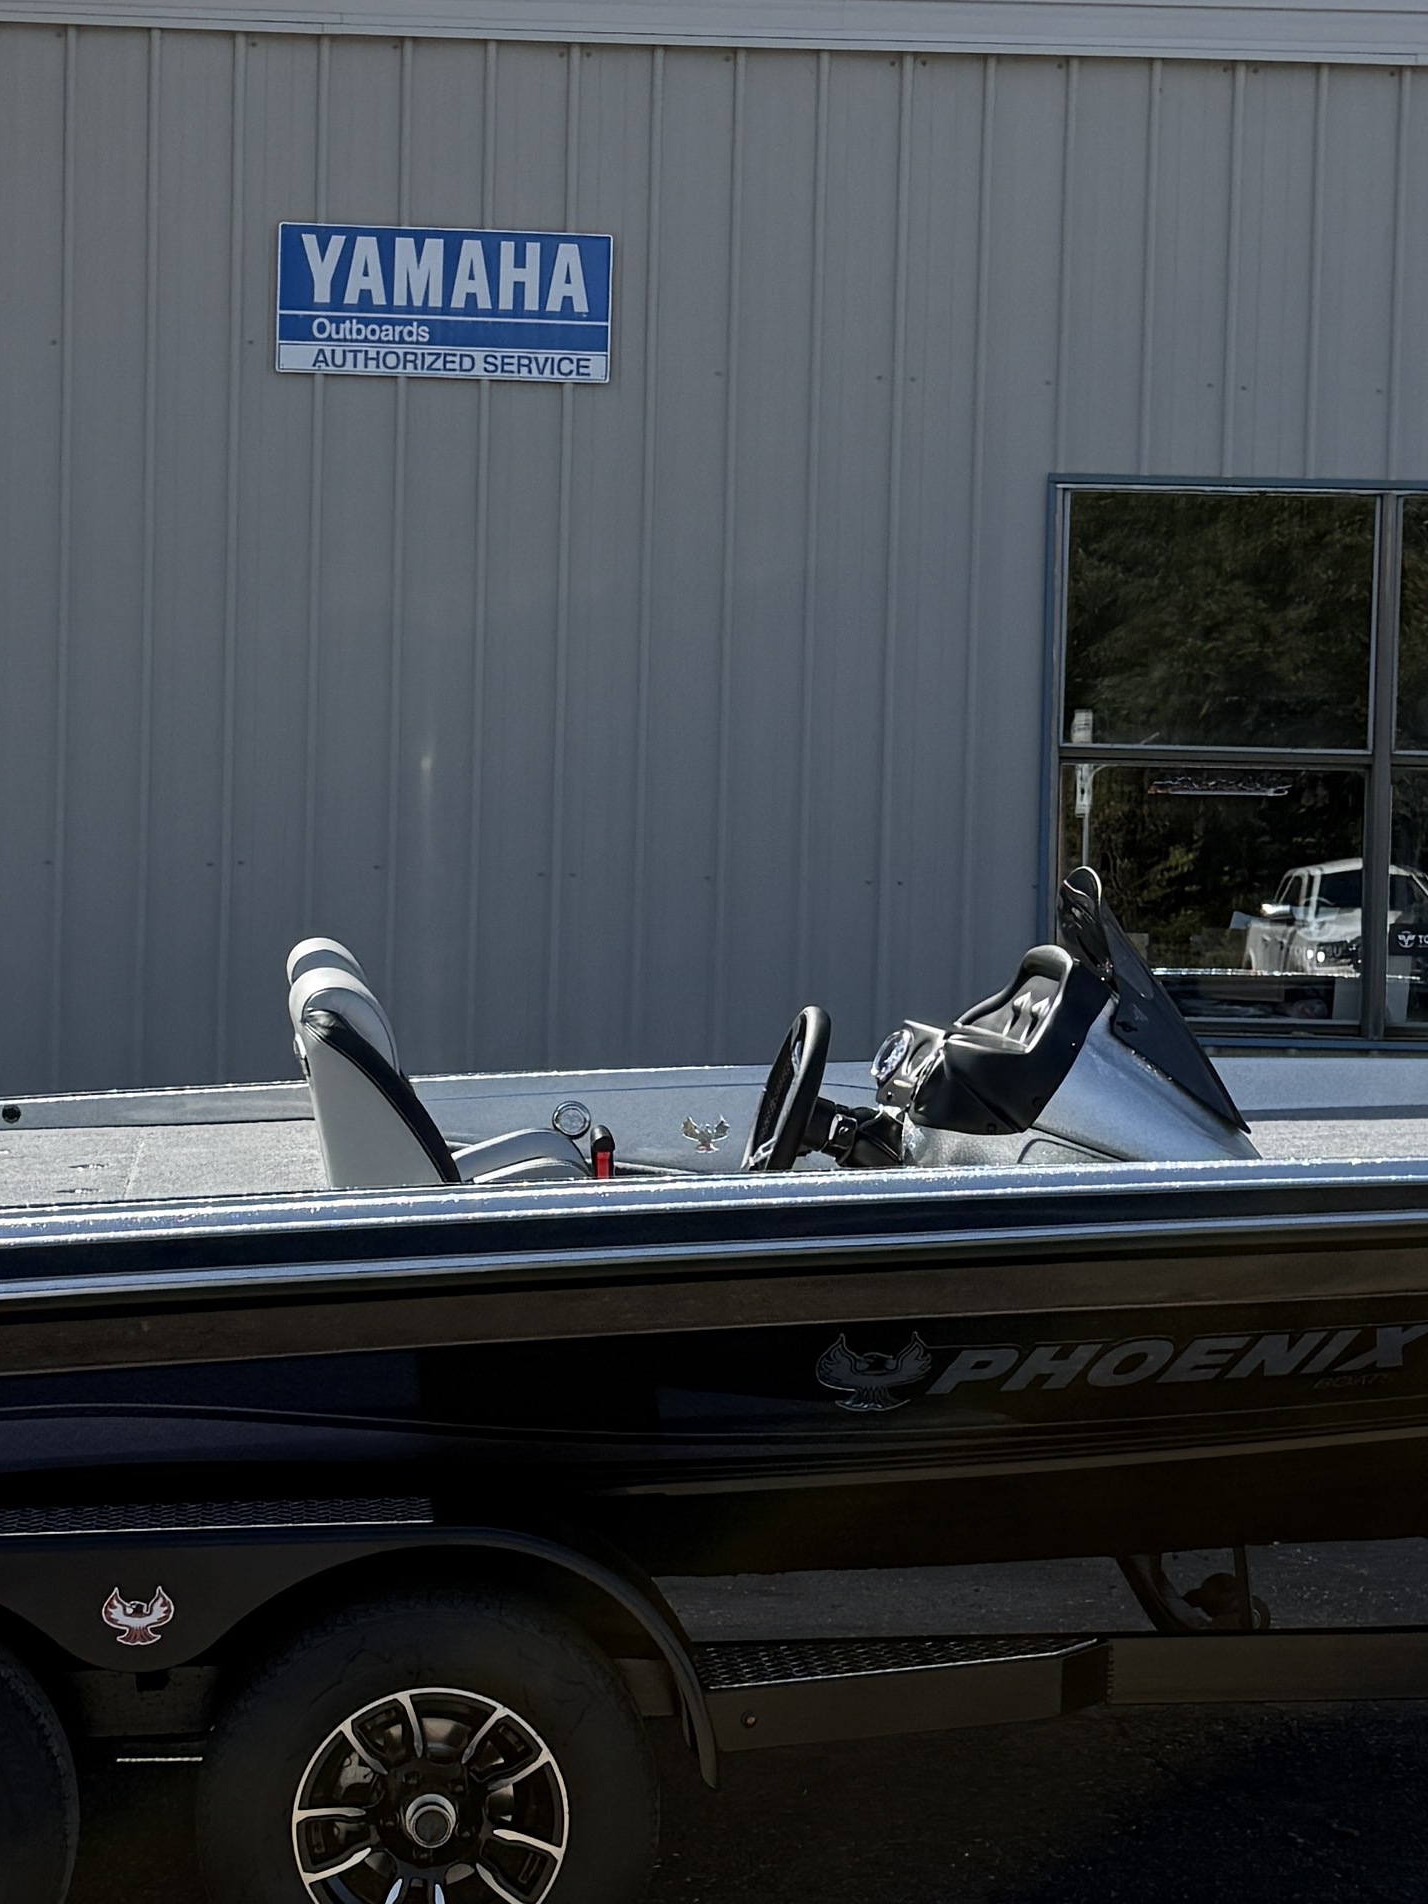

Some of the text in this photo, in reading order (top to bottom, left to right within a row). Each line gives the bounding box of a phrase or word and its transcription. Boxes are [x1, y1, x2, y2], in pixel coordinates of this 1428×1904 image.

[301, 233, 589, 313] YAMAHA
[312, 317, 430, 344] Outboards
[312, 348, 591, 378] AUTHORIZED SERVICE
